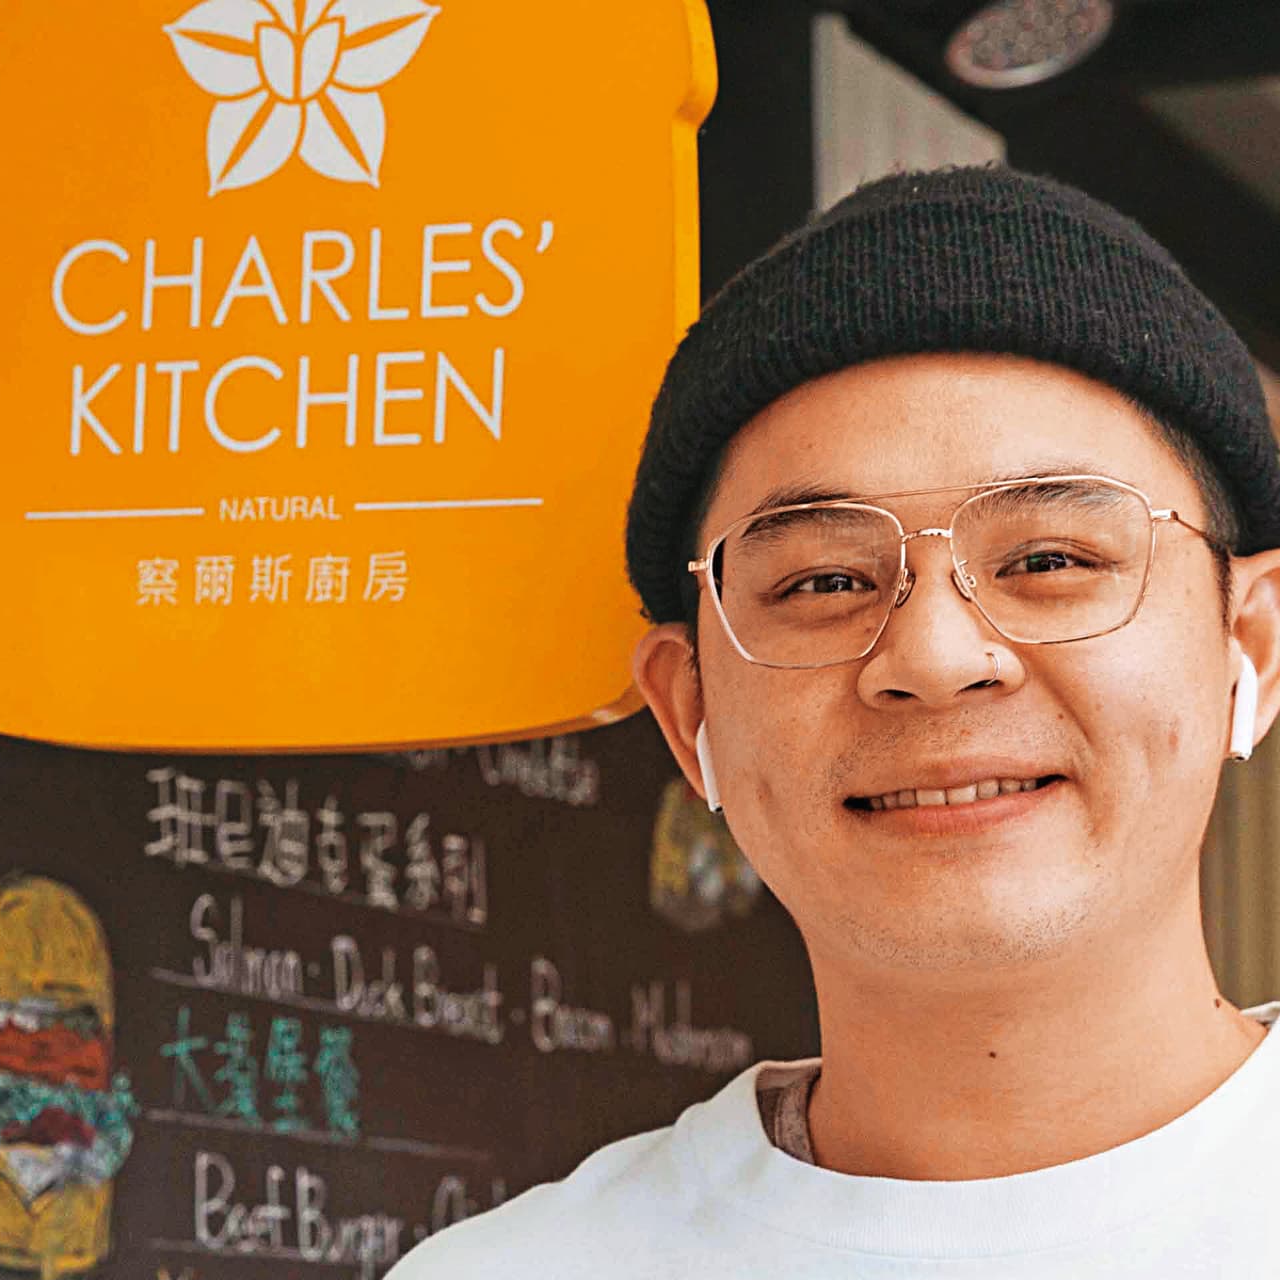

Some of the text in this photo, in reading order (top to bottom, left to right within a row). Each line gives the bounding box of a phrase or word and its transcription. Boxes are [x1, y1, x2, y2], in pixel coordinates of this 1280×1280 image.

[51, 218, 555, 335] CHARLES’
[69, 347, 507, 456] KITCHEN
[218, 495, 342, 521] NATURAL
[135, 550, 411, 606] 察爾斯廚房
